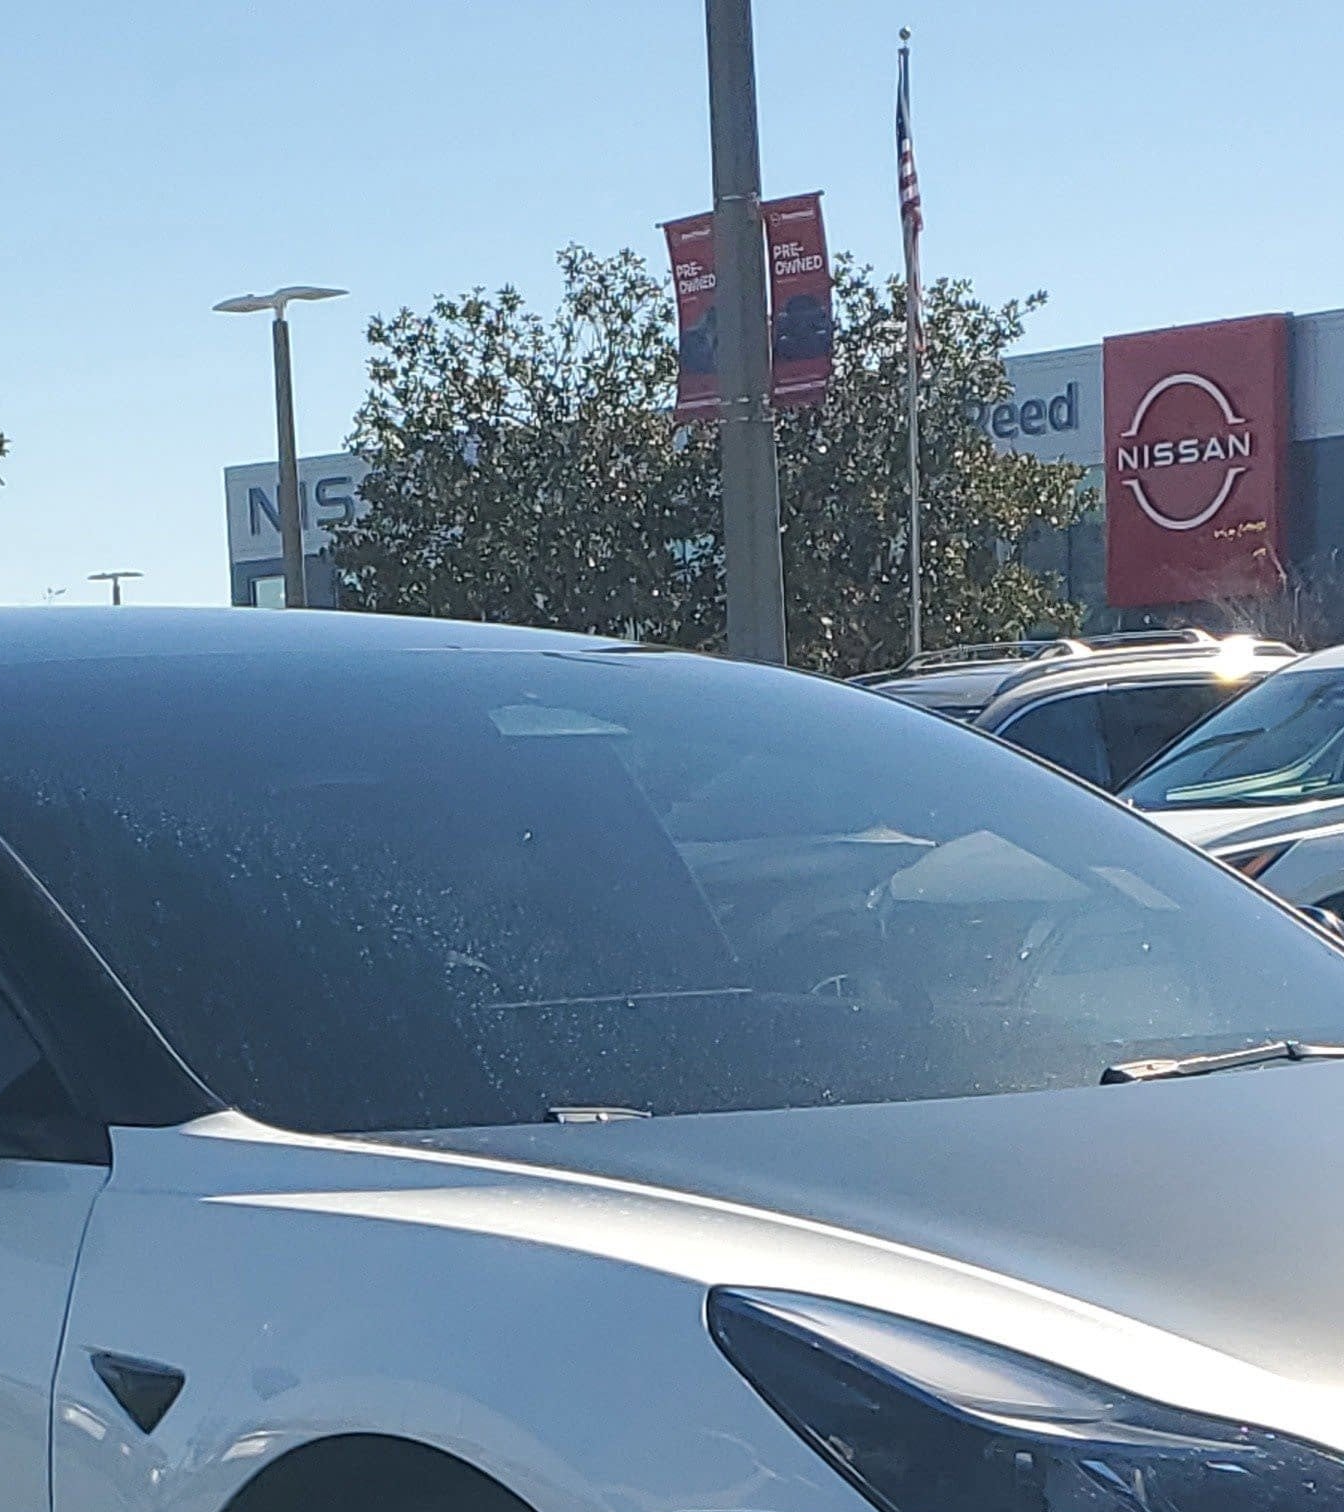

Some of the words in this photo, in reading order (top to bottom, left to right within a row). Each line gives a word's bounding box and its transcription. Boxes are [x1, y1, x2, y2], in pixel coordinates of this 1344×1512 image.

[773, 242, 804, 261] PRE-
[675, 261, 703, 278] PRE-
[775, 255, 823, 276] OWNED
[679, 273, 716, 294] OWNED
[1117, 431, 1250, 472] NISSAN
[248, 475, 356, 537] NIS
